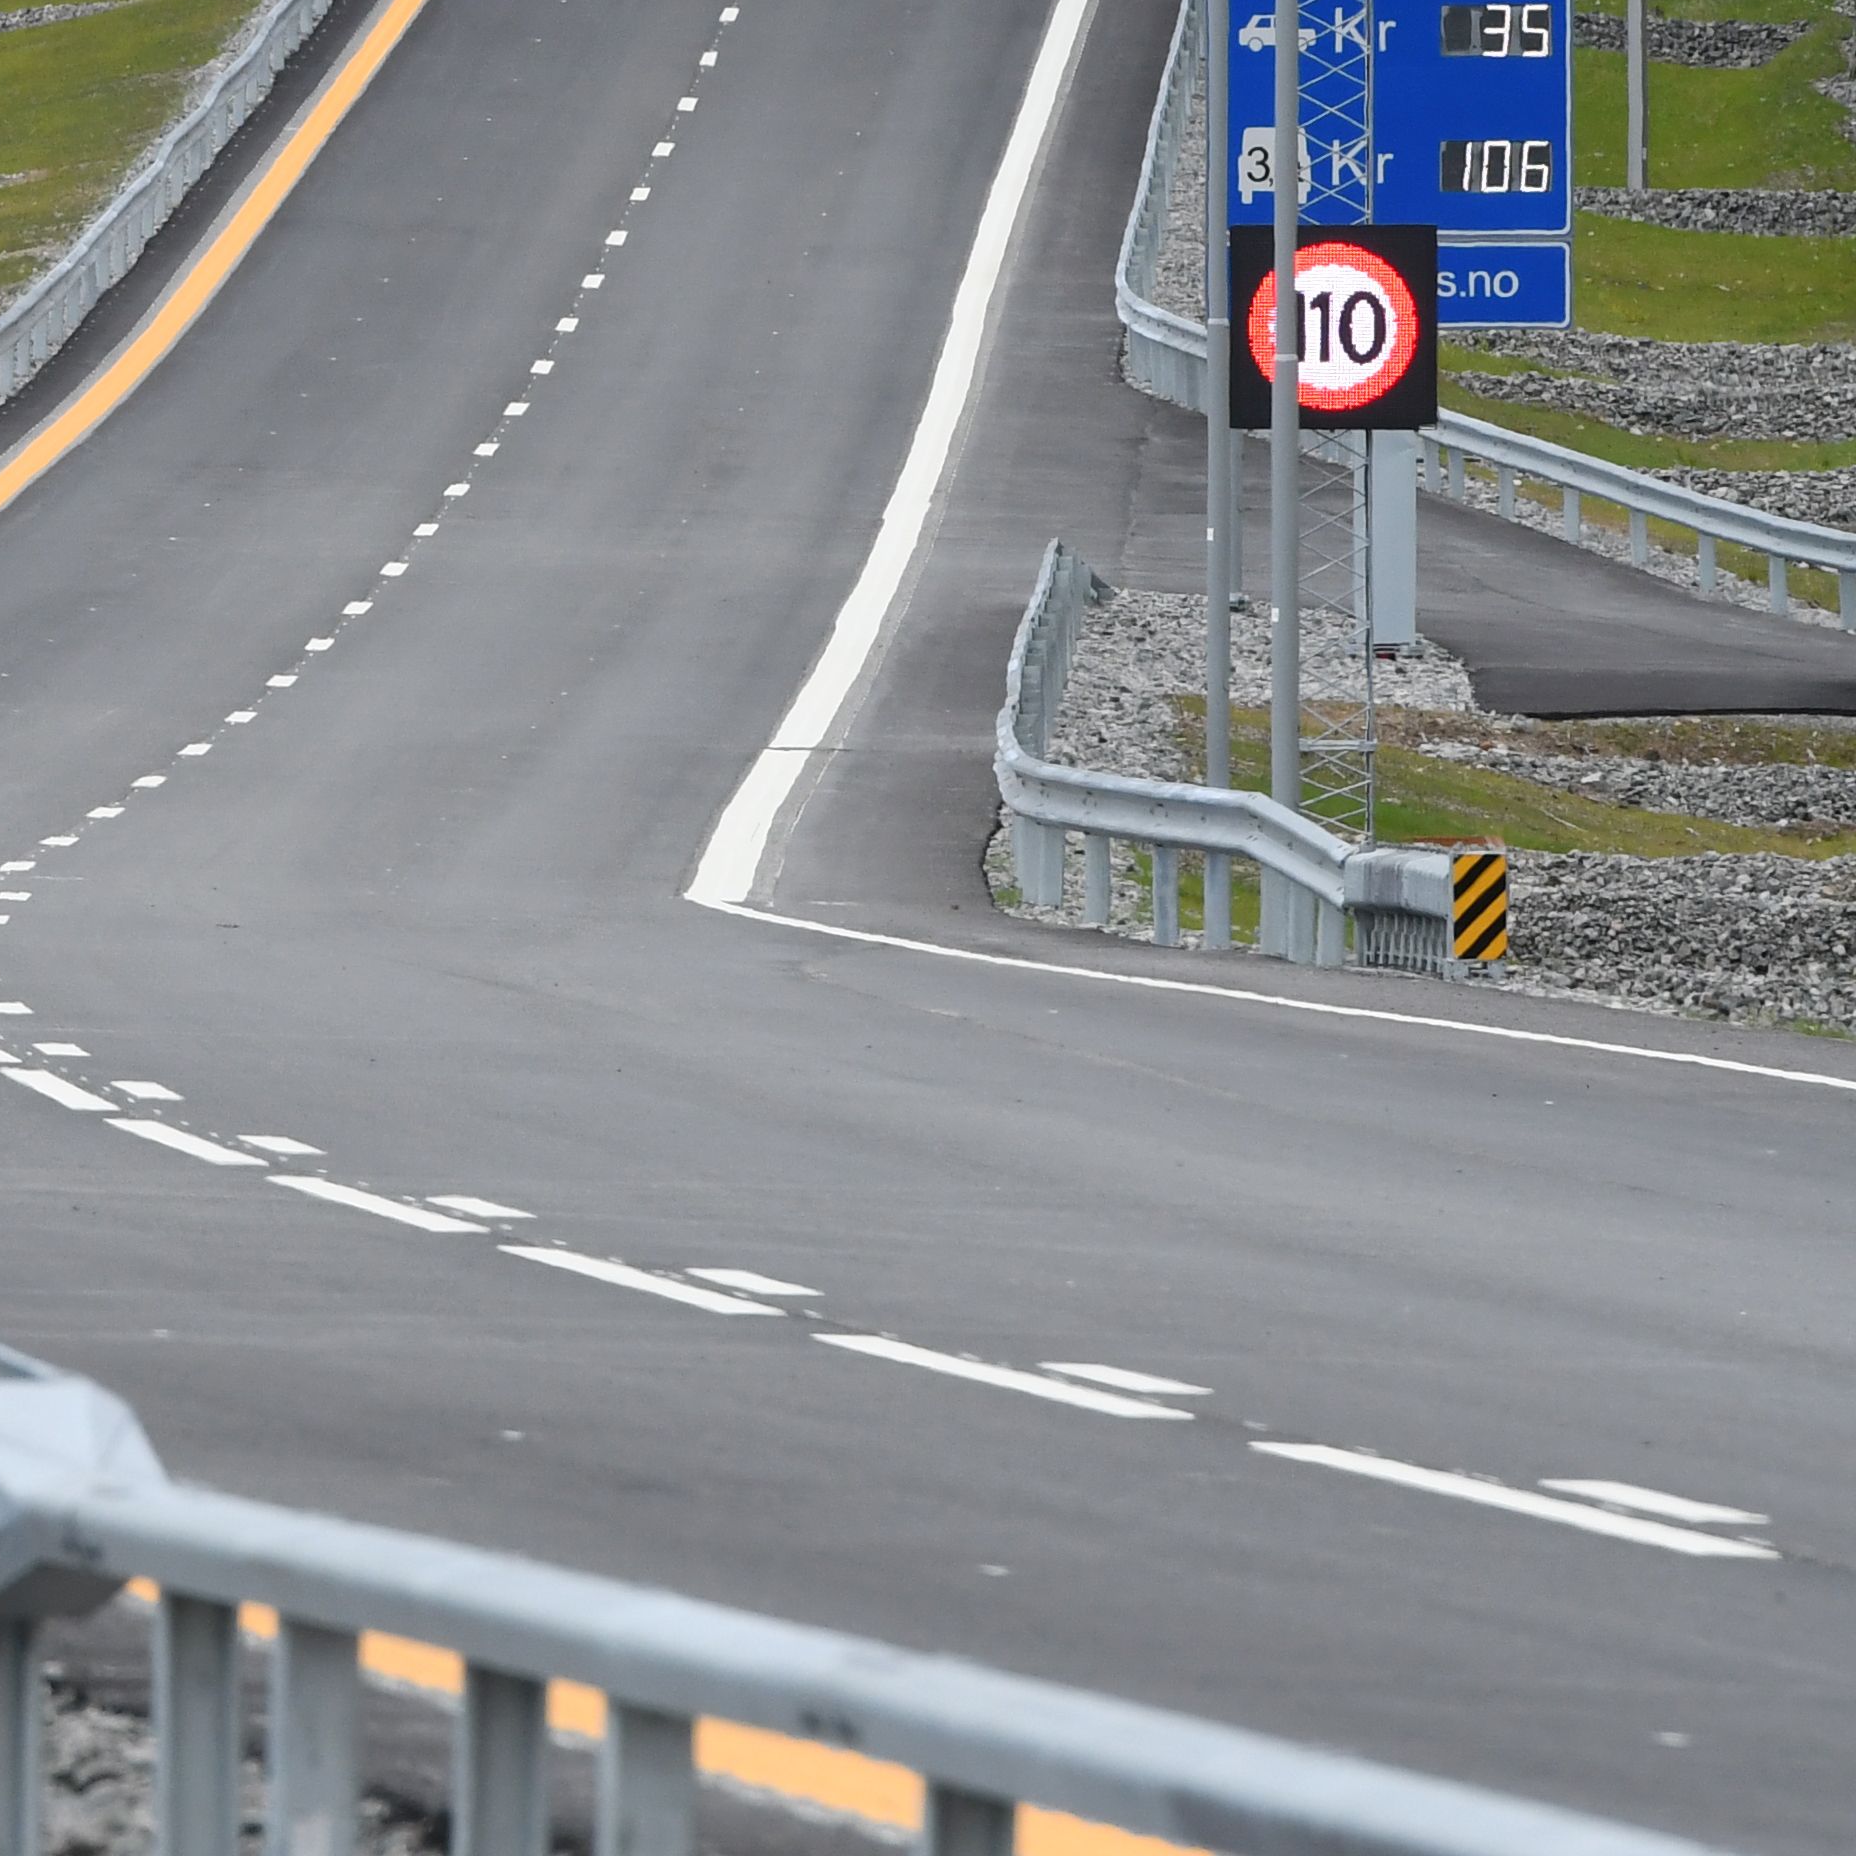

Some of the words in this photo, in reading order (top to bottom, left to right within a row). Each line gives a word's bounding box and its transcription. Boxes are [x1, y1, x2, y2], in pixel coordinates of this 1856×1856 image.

[1335, 7, 1397, 53] Kr
[1482, 4, 1549, 58] 35
[1332, 139, 1394, 186] Kr
[1462, 140, 1549, 193] 106
